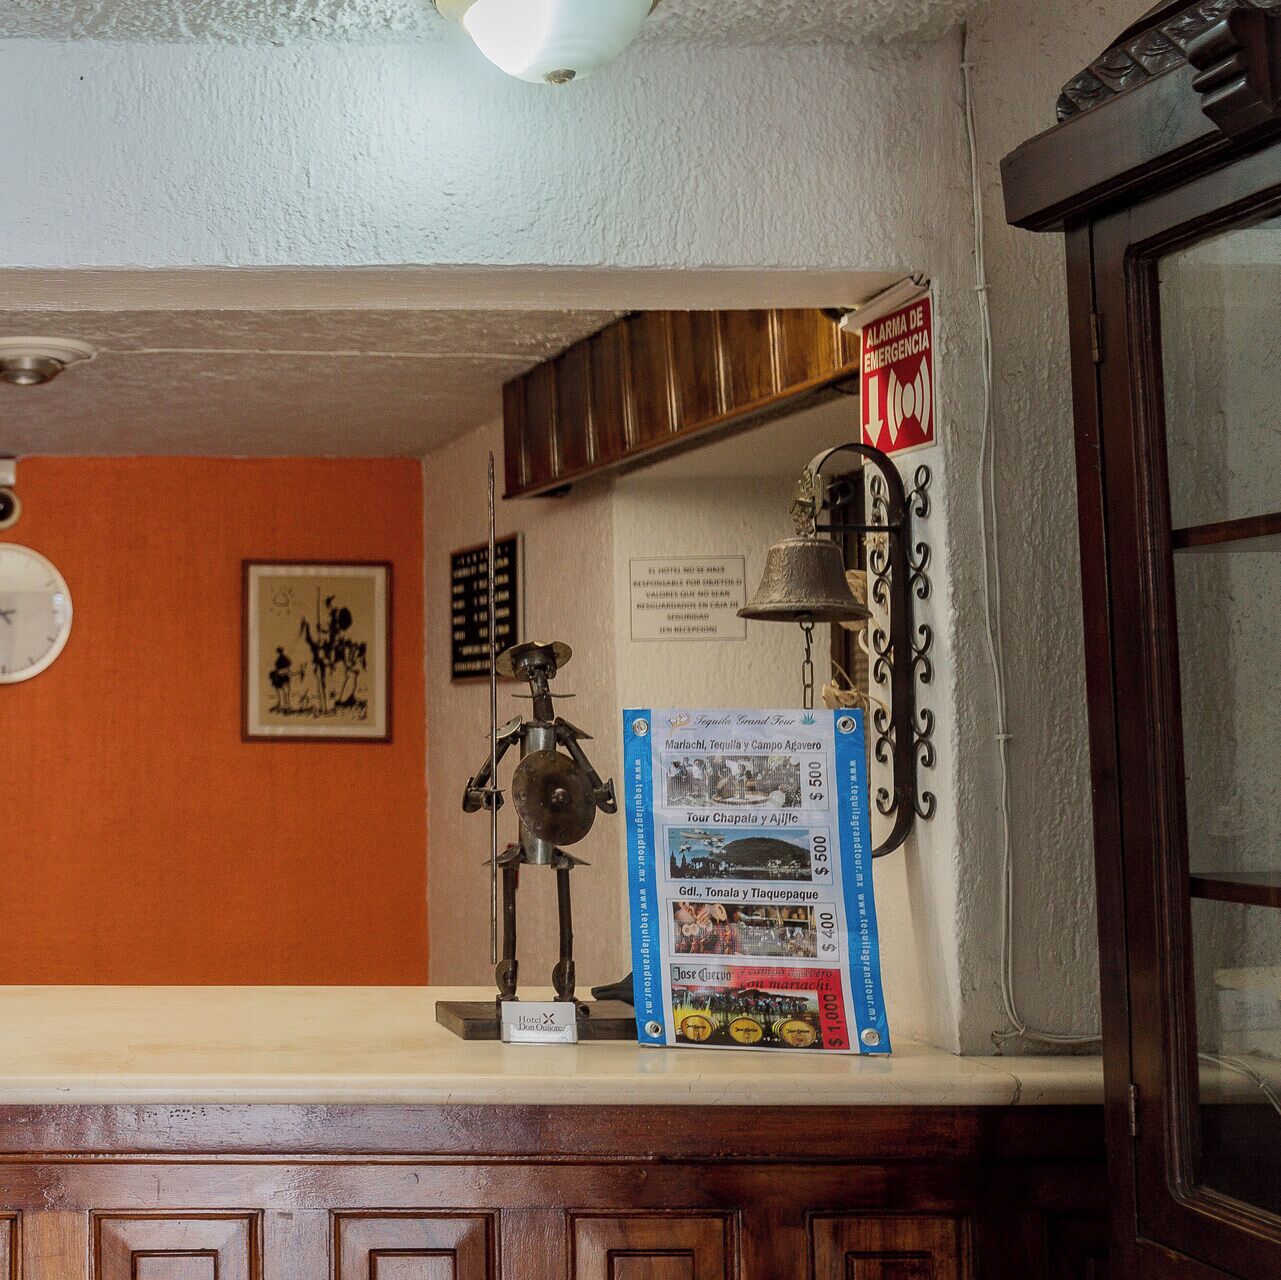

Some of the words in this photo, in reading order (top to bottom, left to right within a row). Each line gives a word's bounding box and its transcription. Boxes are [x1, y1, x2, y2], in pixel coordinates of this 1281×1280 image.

[866, 313, 908, 349] ALARMA
[909, 305, 924, 328] DE
[864, 329, 930, 374] EMERGENCIA
[694, 714, 733, 728] Tequila
[735, 714, 766, 727] Grand
[770, 714, 796, 726] Tour
[665, 739, 707, 751] Mariachi,
[710, 739, 741, 751] Tequila
[744, 742, 749, 751] y
[752, 740, 783, 752] Campo
[784, 740, 822, 752] Agavero
[809, 762, 822, 788] 500
[809, 792, 824, 801] $
[634, 758, 647, 883] www.tequilagrandtour.mx
[686, 812, 710, 823] Tour
[712, 812, 758, 825] Chapala
[761, 815, 768, 826] y
[849, 759, 864, 887] www.tequilagrandtour.mx
[813, 835, 827, 862] 500
[814, 867, 829, 876] $
[679, 886, 702, 898] Gdl.,
[705, 887, 740, 898] Tonala
[742, 890, 748, 899] y
[751, 888, 819, 900] Tlaquepaque
[820, 912, 835, 939] 400
[639, 888, 653, 1015] www.tequilagrandtour.mx
[821, 943, 837, 952] $
[857, 893, 877, 1021] www.tequilagrandtour.mx
[672, 966, 696, 982] Jose
[698, 968, 732, 983] Cuervo
[740, 979, 764, 990] con
[769, 979, 833, 991] mariachi.
[518, 1015, 541, 1024] Hotel
[823, 993, 842, 1034] 1,000
[518, 1023, 535, 1031] Don
[828, 1037, 843, 1047] $
